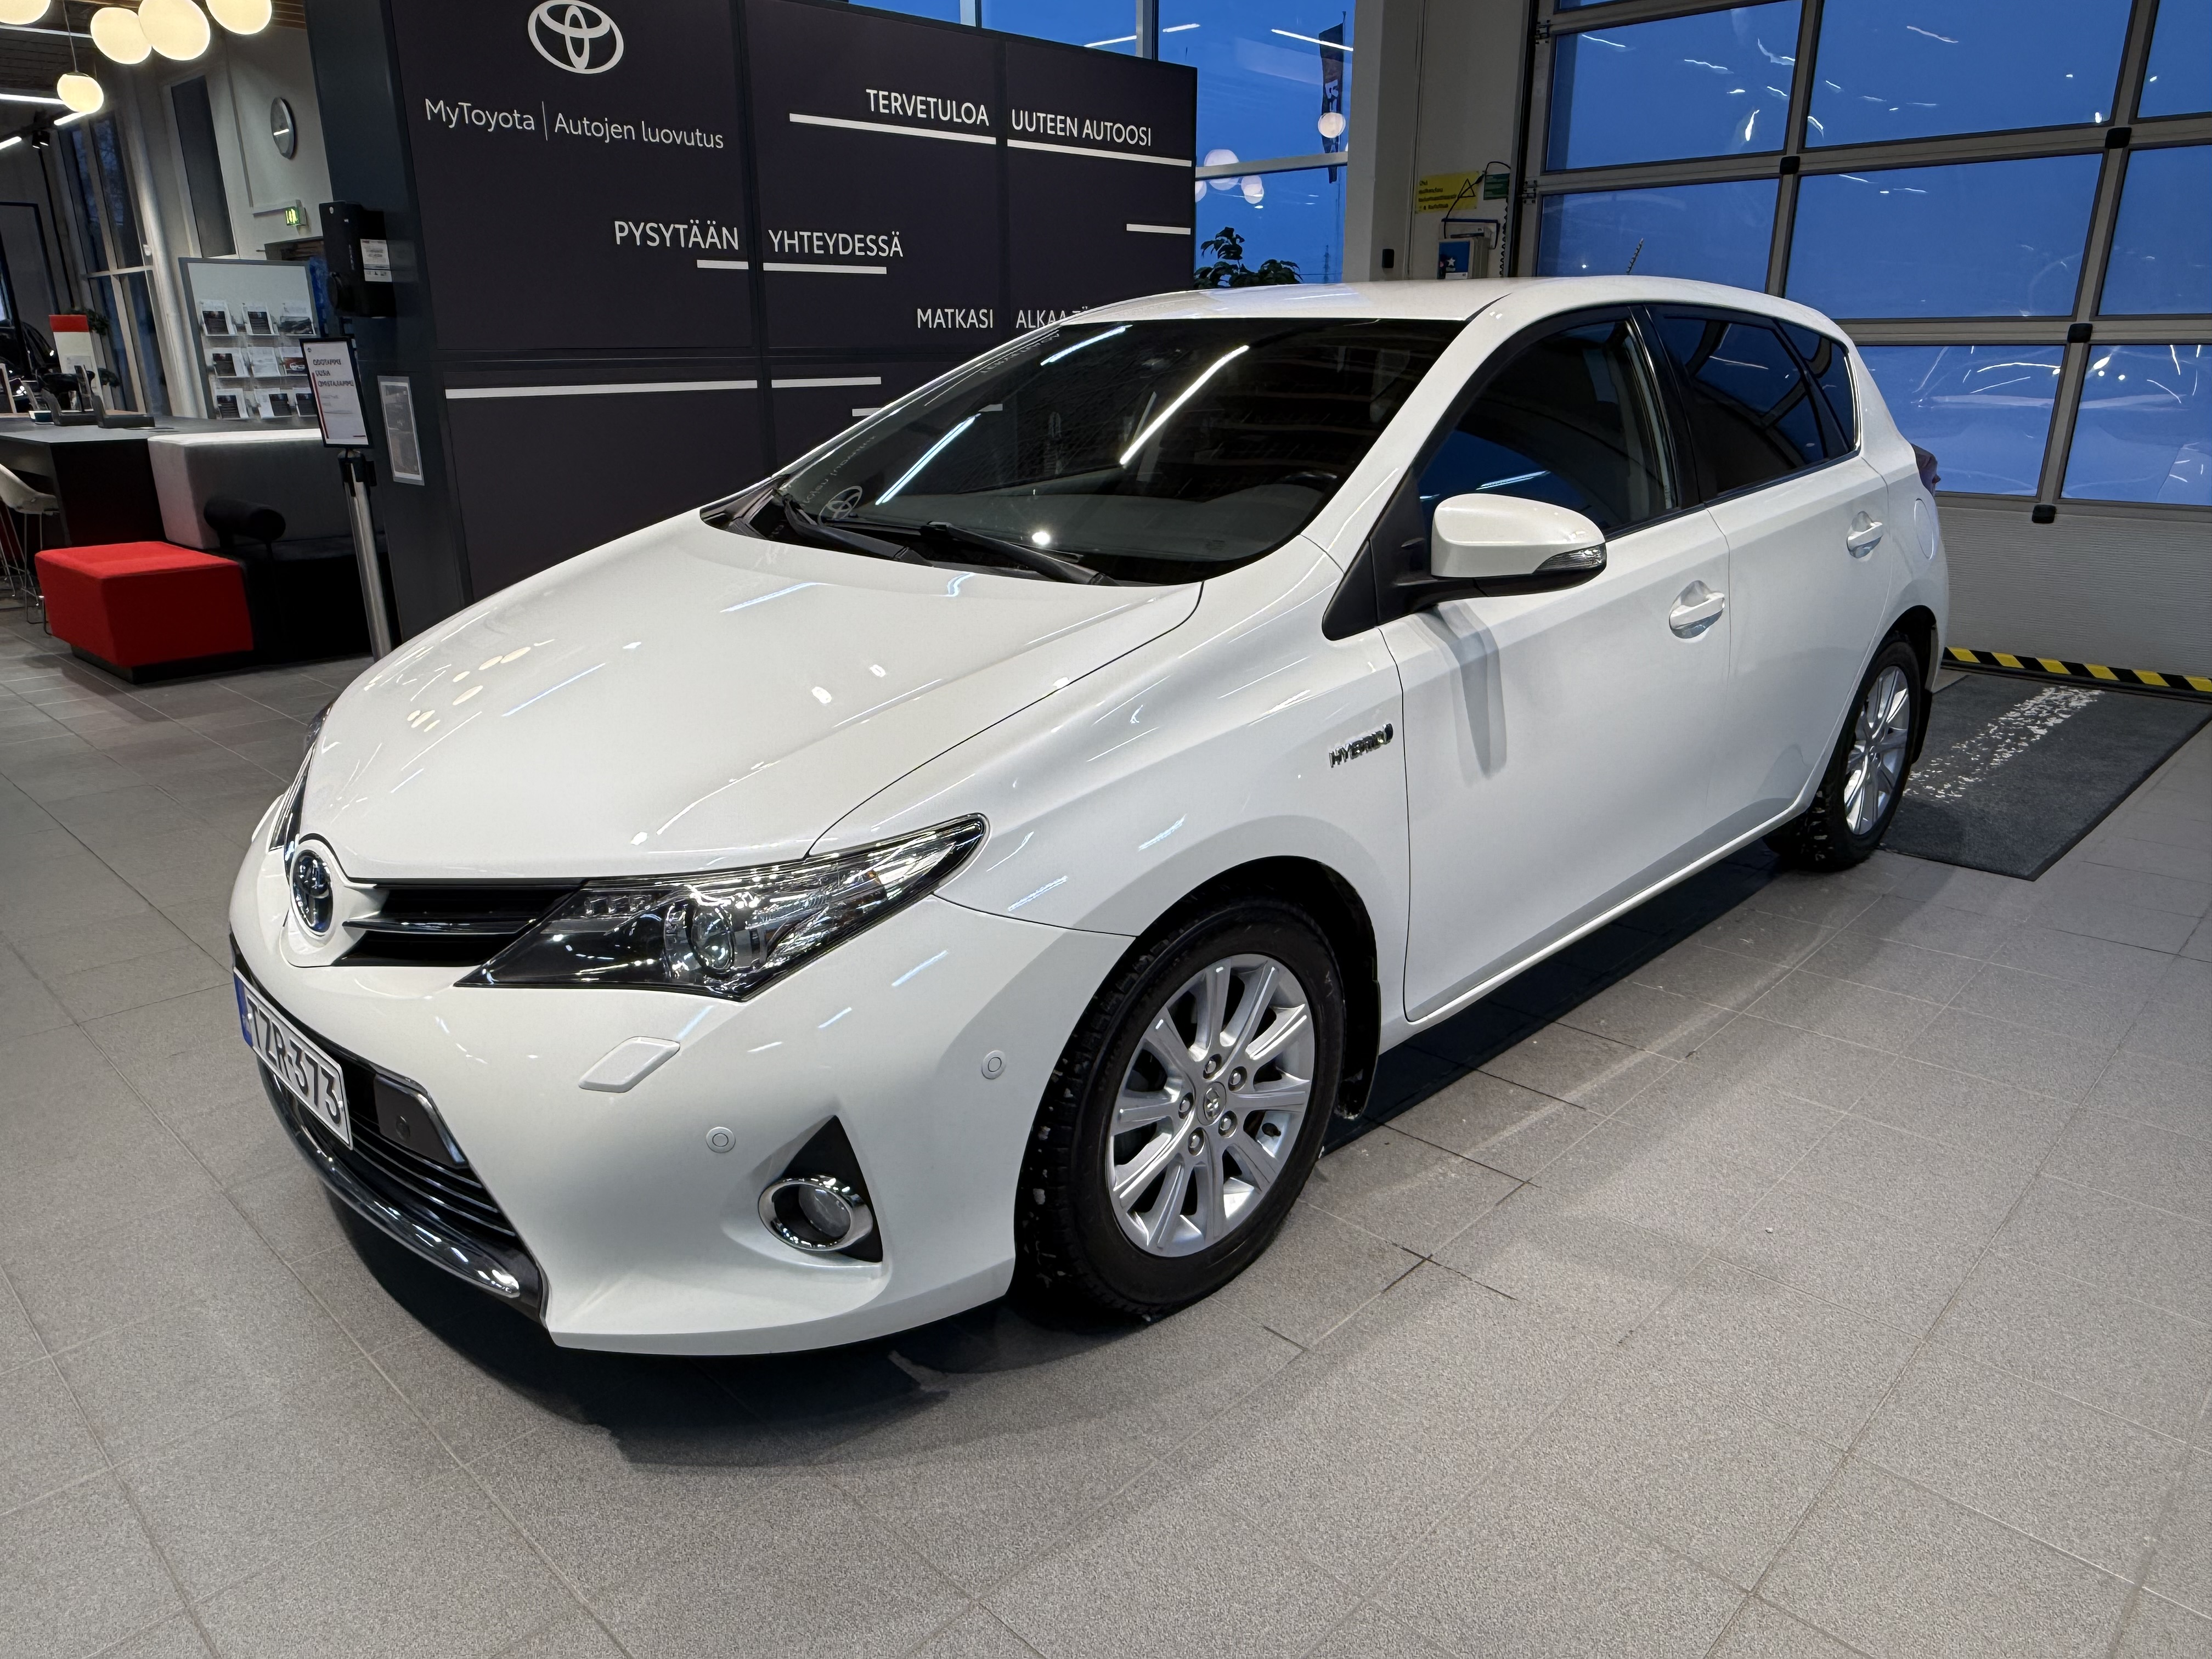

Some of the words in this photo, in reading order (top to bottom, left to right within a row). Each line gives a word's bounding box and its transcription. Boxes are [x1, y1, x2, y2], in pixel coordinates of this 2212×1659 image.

[426, 99, 534, 132] MyToyota
[555, 113, 635, 143] Autojen
[642, 121, 723, 148] luovutus
[866, 89, 989, 126] TERVETULOA
[1012, 109, 1077, 138] UUTEEN
[1082, 120, 1150, 146] AUTOOSI
[615, 218, 738, 250] PYSYTÄÄN
[769, 230, 903, 257] YHTEYDESSÄ
[917, 309, 992, 328] MATKASI
[1329, 730, 1387, 768] HYBRID
[247, 995, 340, 1126] TZR-373
